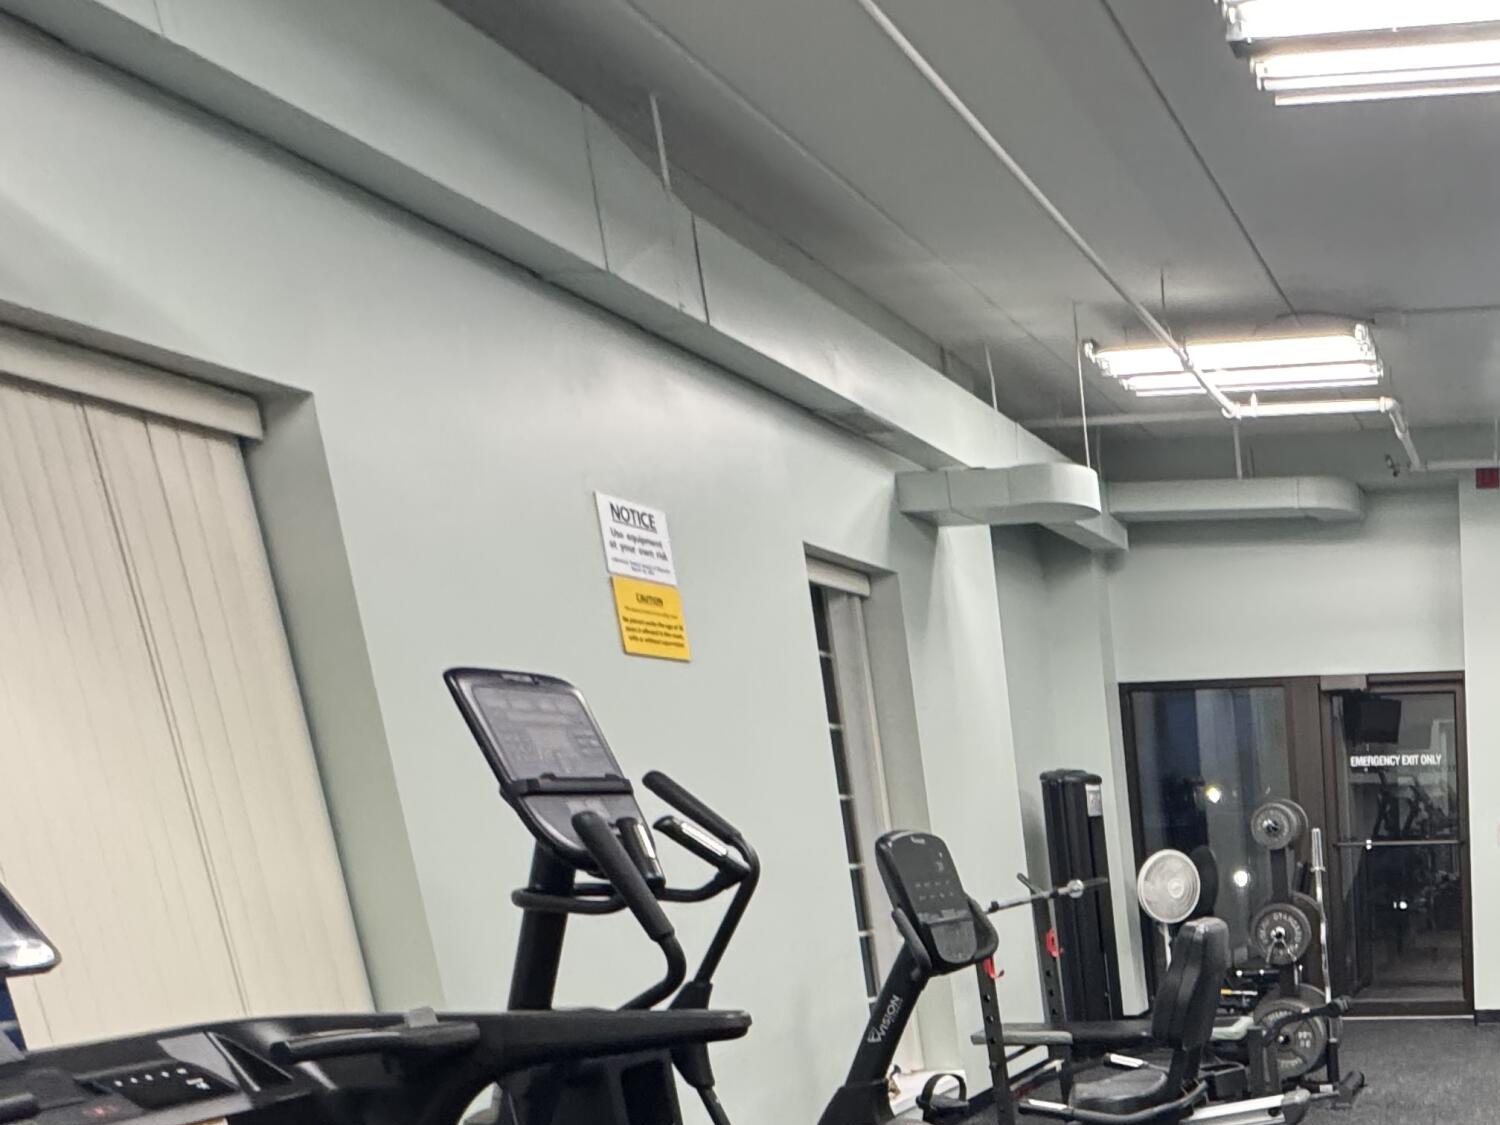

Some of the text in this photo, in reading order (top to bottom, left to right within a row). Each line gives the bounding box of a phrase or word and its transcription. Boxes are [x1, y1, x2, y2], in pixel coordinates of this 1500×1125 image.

[609, 502, 656, 531] NOTICE
[1350, 754, 1442, 768] EMERGENCY EXIT ONLY
